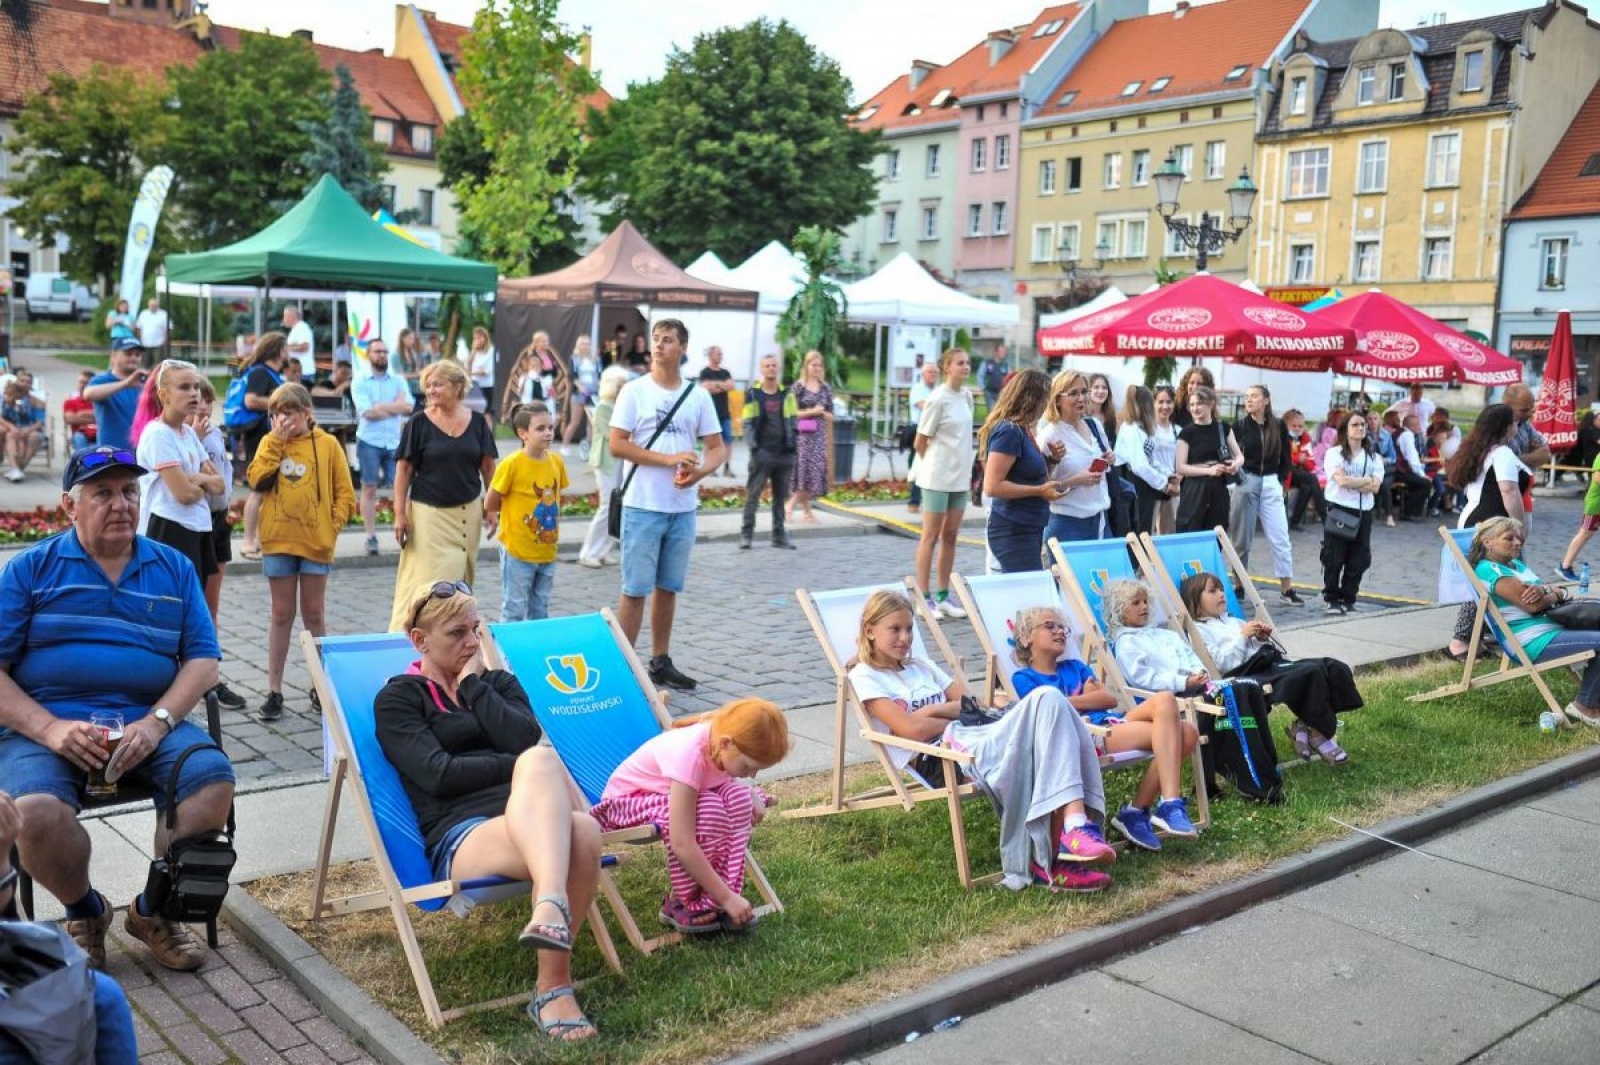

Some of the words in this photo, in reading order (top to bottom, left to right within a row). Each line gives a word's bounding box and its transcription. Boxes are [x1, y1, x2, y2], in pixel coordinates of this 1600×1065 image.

[1117, 335, 1225, 350] RACIBORSKIE
[1255, 335, 1345, 350] RACIBORSKIE
[1344, 360, 1444, 380] RACIBORSKIE
[548, 696, 623, 715] WODZISŁAWSKI
[912, 691, 942, 712] SALTY
